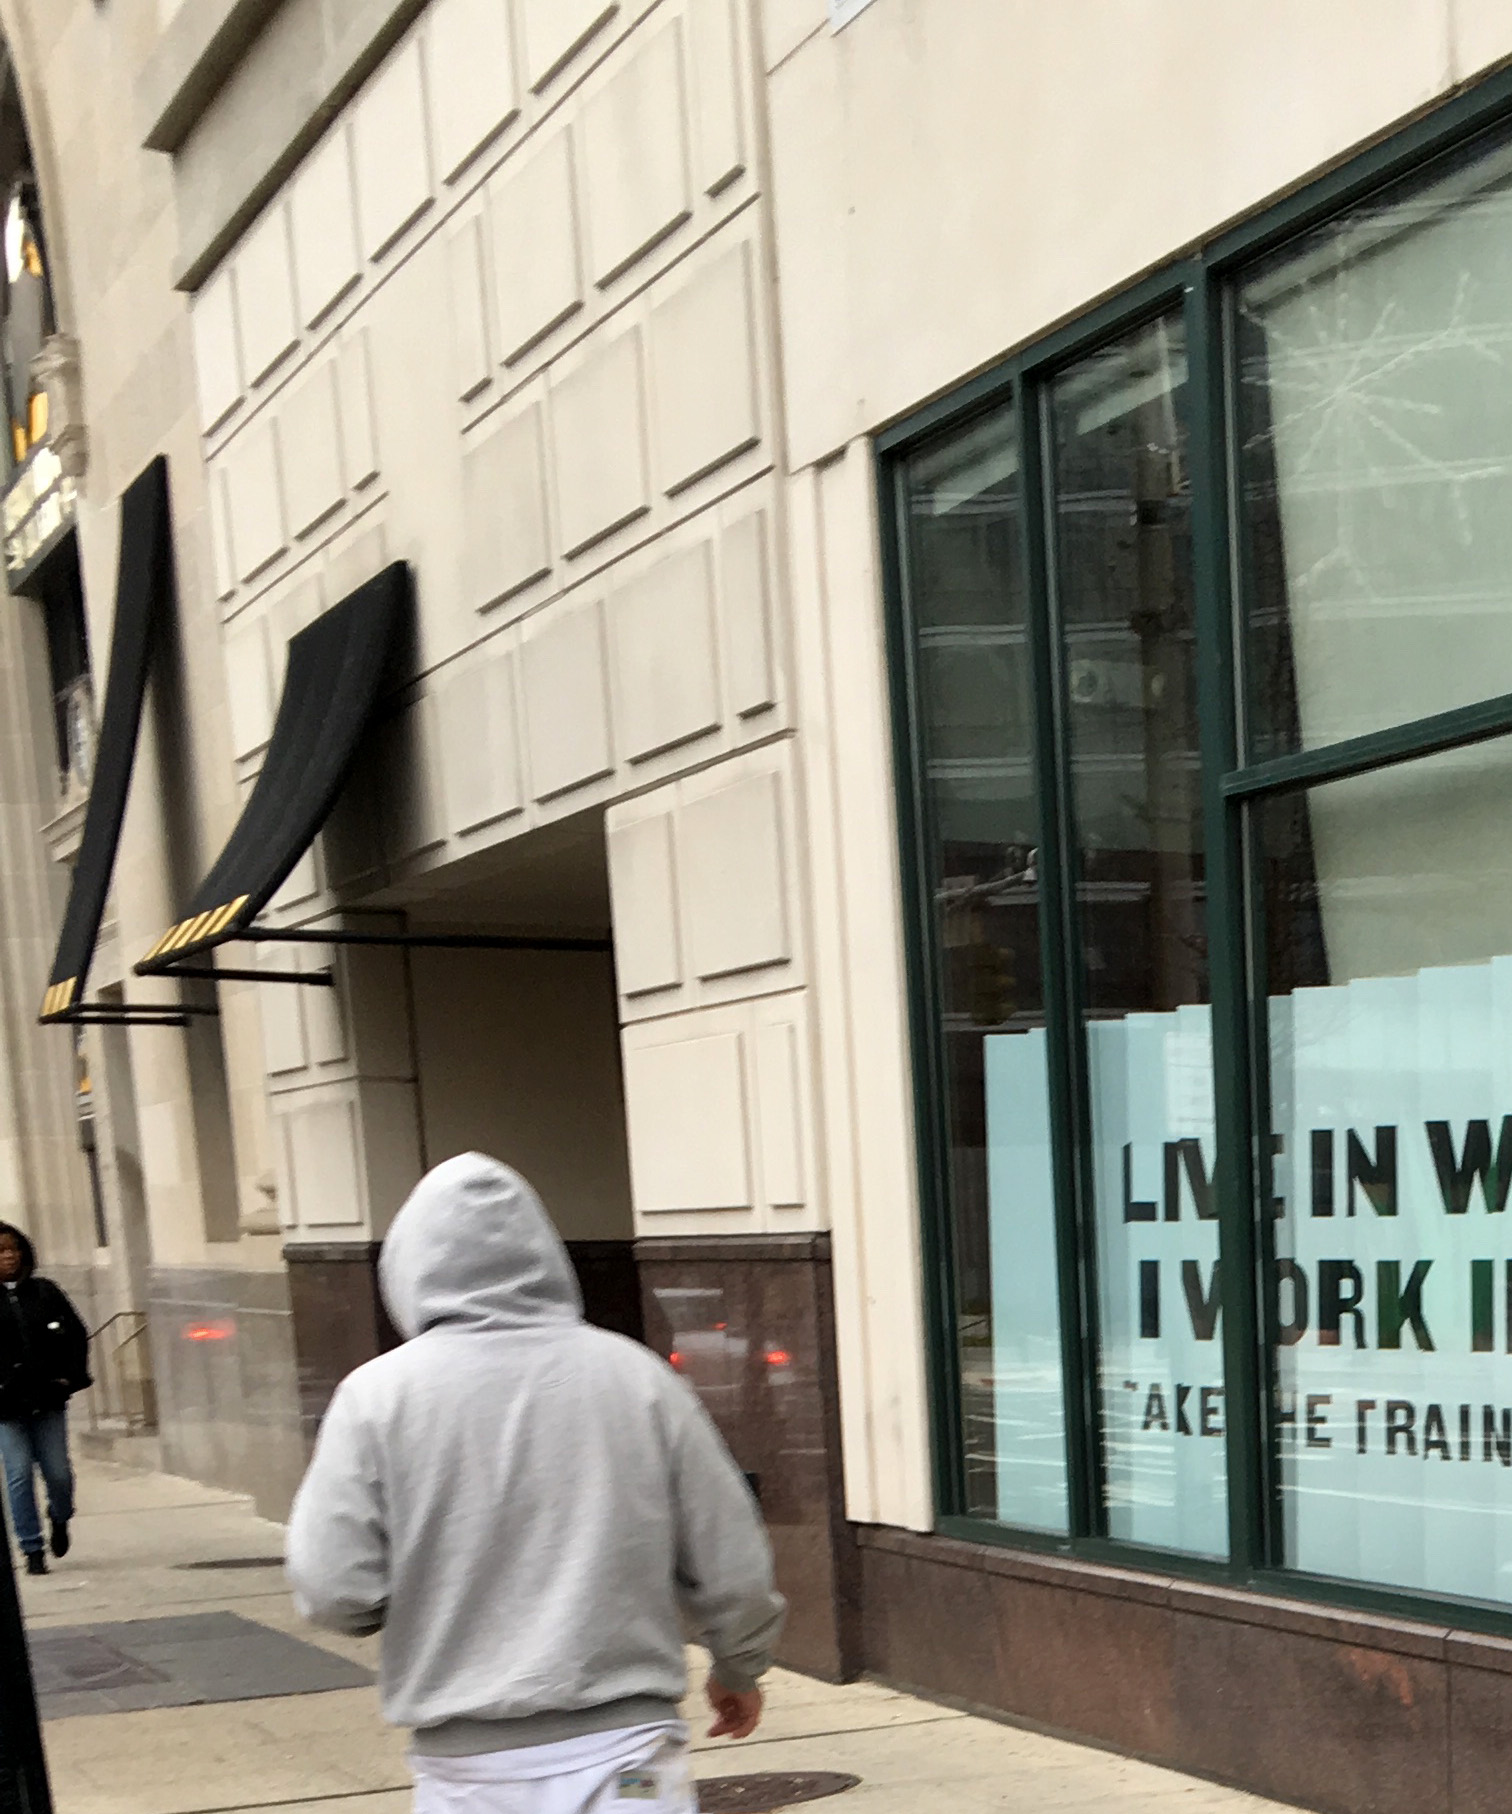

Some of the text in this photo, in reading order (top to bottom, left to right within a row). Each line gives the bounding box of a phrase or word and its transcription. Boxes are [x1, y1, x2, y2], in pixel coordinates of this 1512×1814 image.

[1310, 1125, 1398, 1218] IN
[1139, 1259, 1160, 1339] I
[1122, 1380, 1225, 1437] AKE
